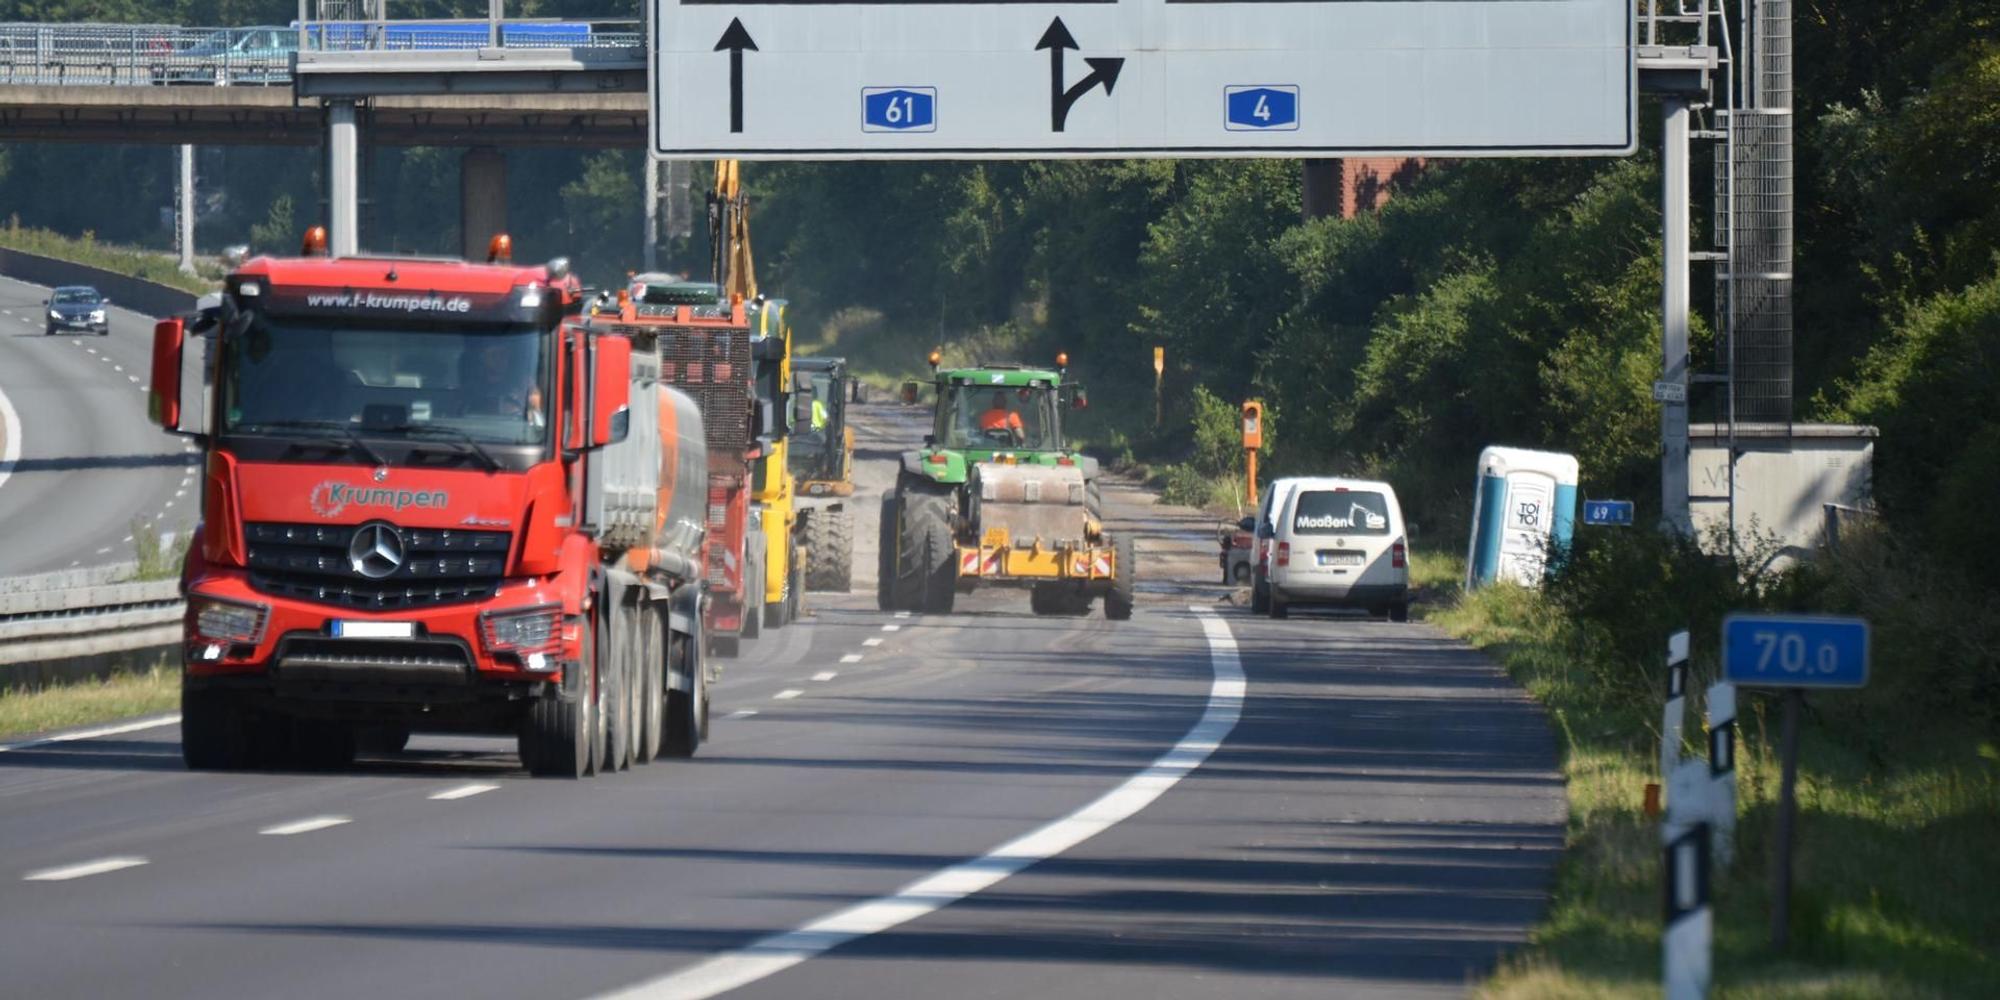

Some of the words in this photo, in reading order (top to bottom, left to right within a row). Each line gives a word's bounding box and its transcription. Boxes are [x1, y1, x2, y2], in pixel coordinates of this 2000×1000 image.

[886, 96, 913, 123] 61
[1253, 94, 1271, 121] 4
[329, 483, 449, 510] Krumpen
[1517, 511, 1538, 526] TOI
